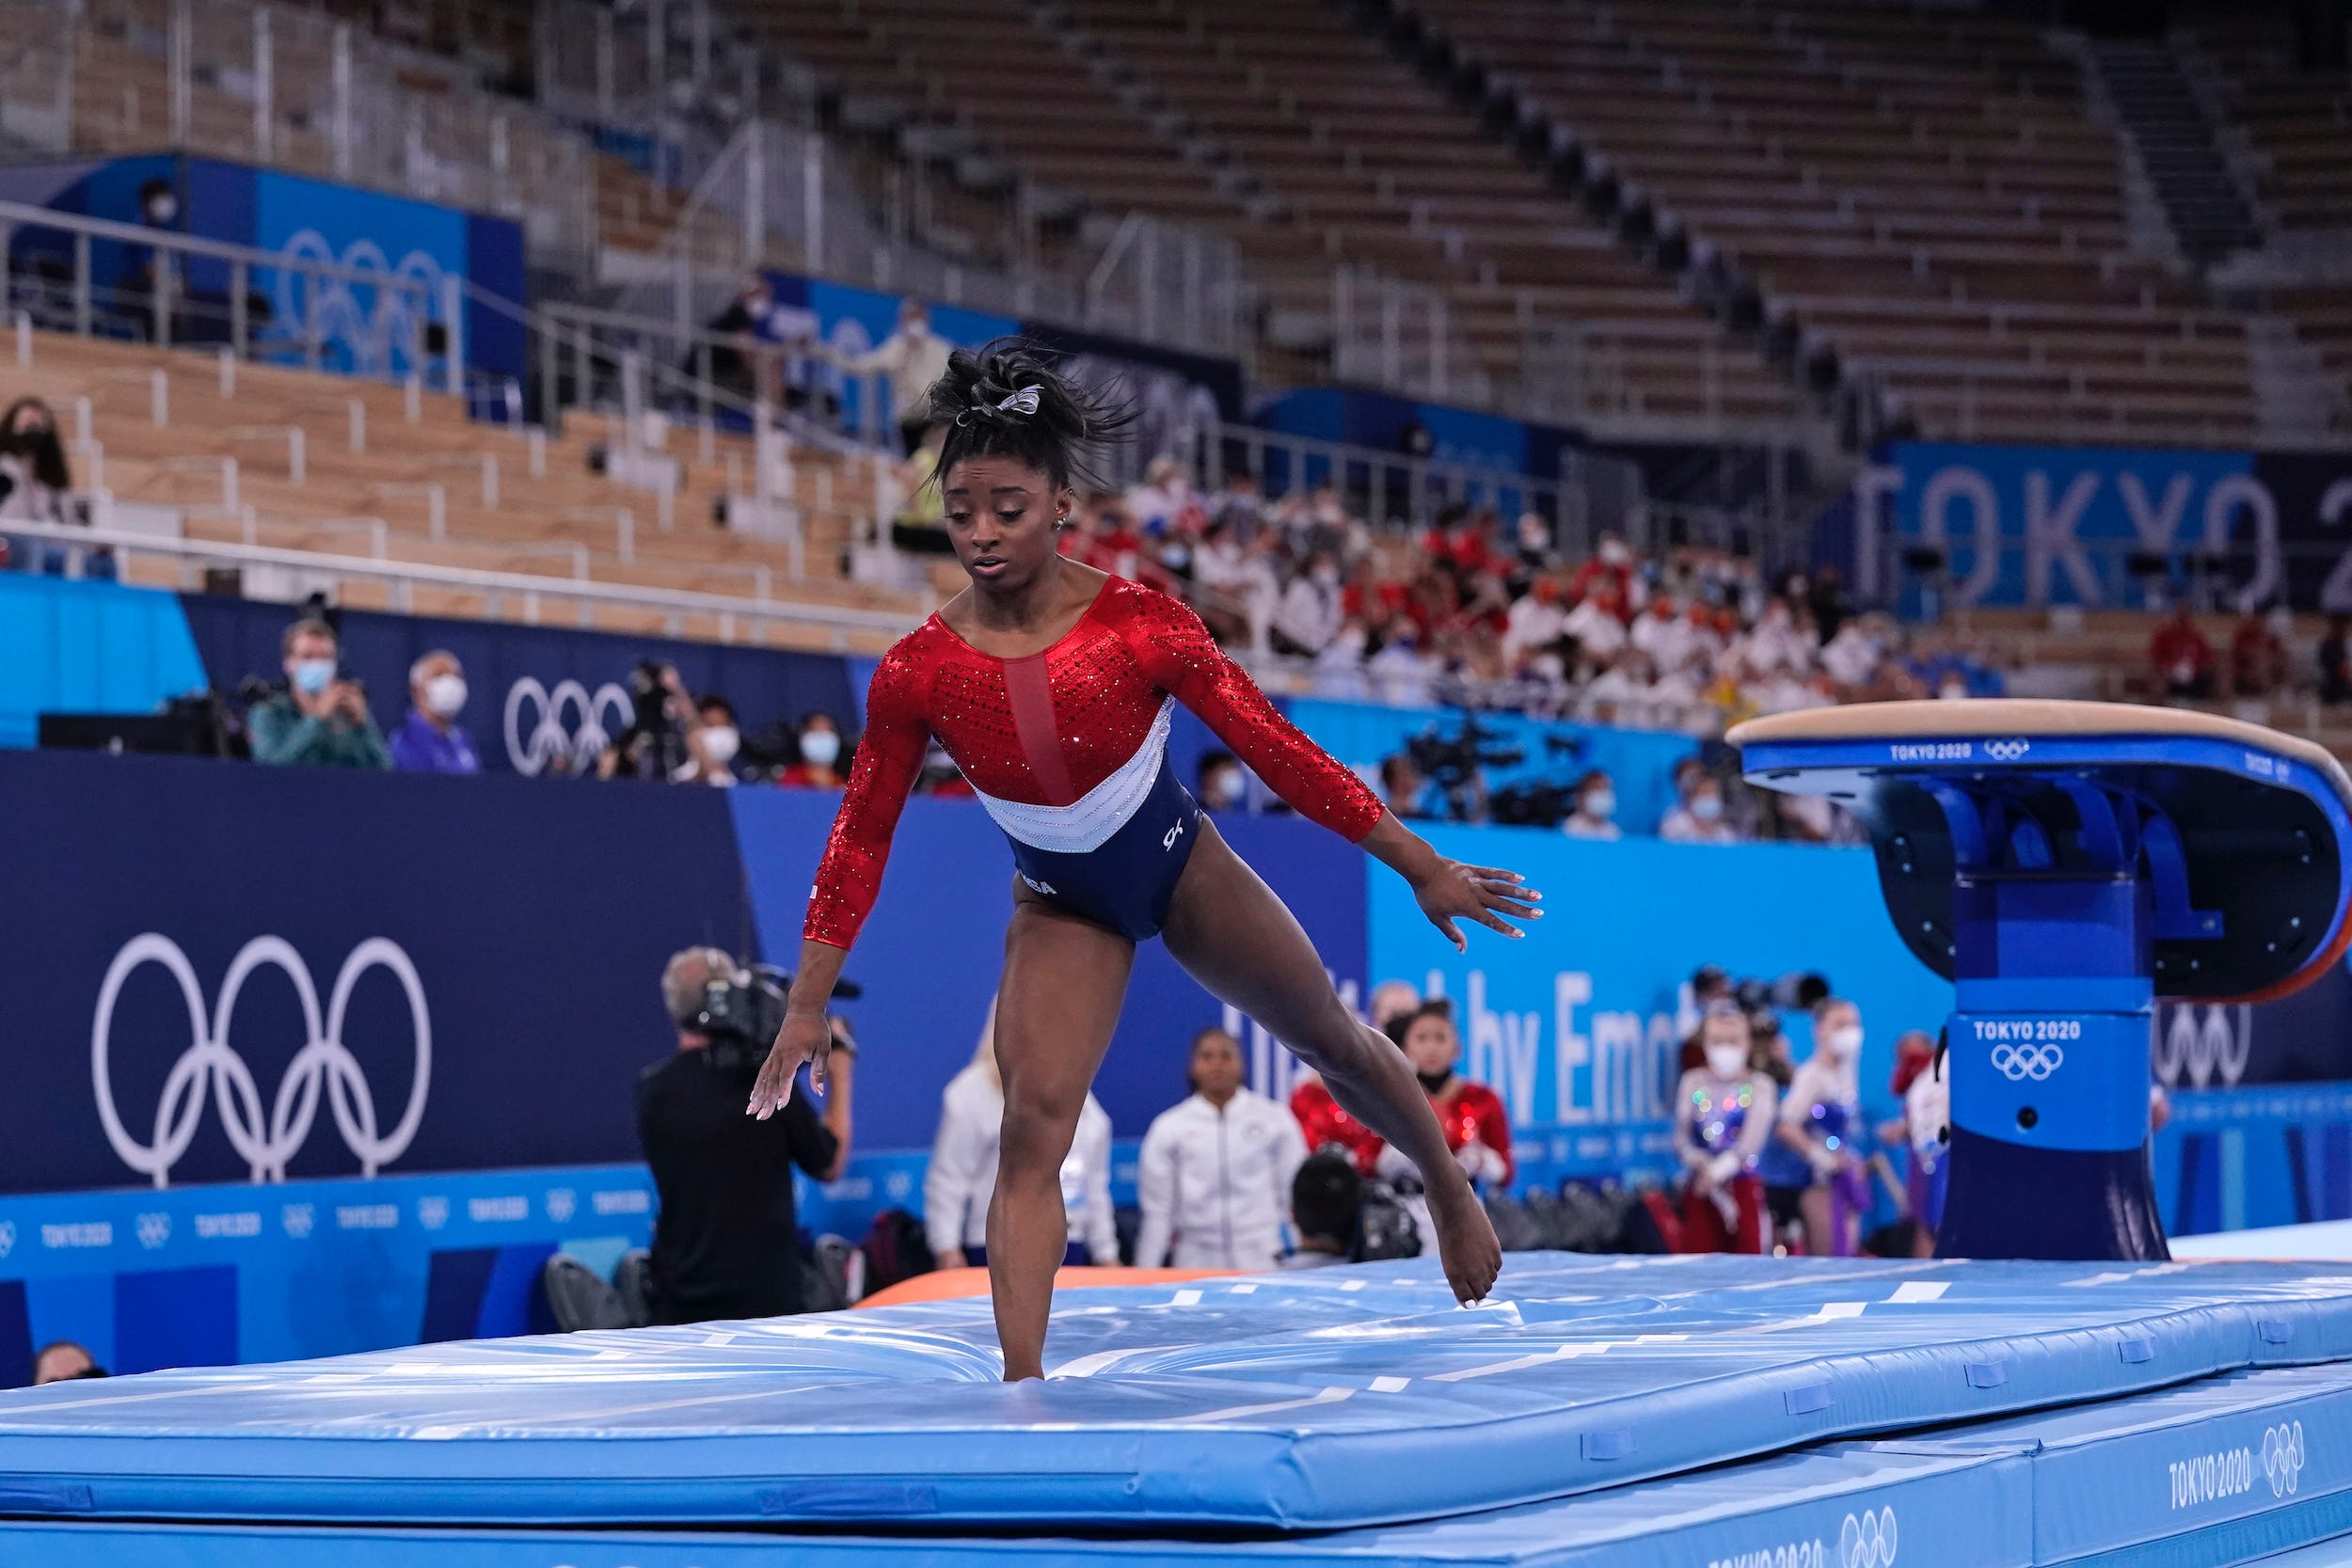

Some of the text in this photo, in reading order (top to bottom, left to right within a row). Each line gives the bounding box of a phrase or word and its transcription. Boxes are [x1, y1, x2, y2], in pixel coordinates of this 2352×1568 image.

[1890, 742, 1972, 761] TOKYO 2020
[1974, 1020, 2081, 1040] TOKYO 2020
[2169, 1447, 2250, 1510] TOKYO 2020
